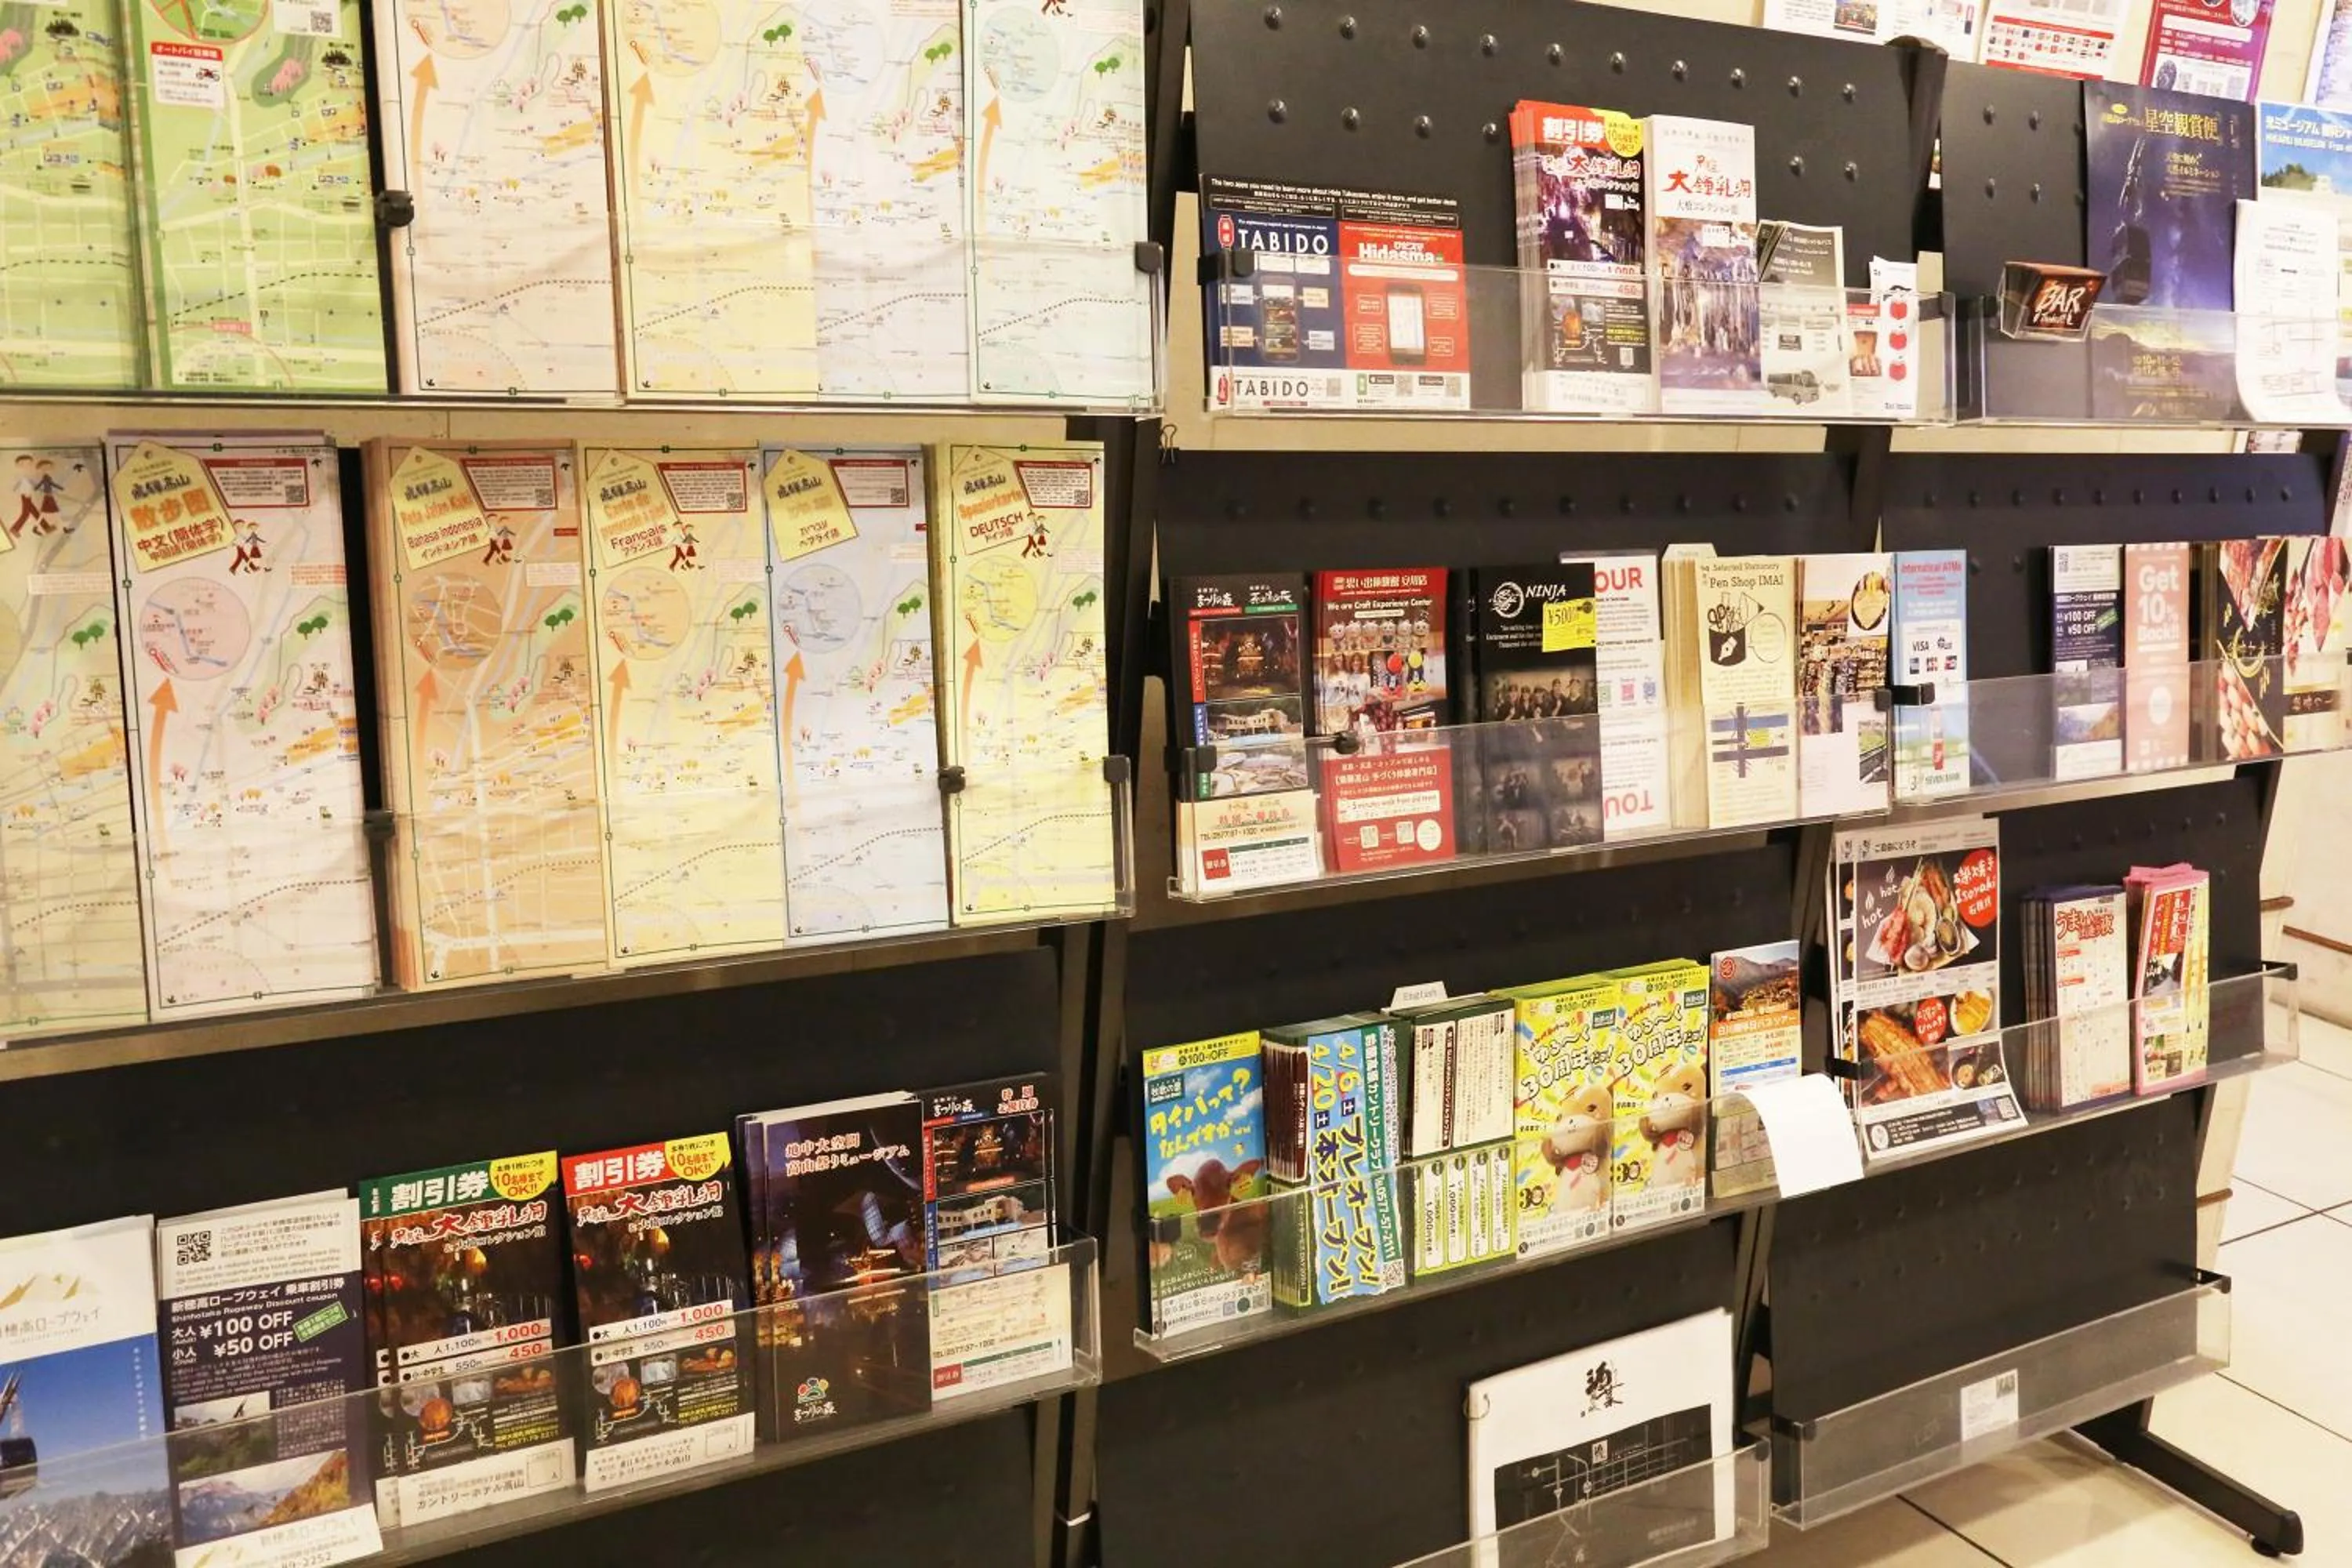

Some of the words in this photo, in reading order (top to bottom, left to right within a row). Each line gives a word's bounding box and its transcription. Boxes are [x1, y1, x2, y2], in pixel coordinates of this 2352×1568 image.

[1543, 117, 1606, 143] 割引券
[1238, 227, 1330, 256] TABIDO
[1358, 242, 1436, 263] Hidasma
[2035, 283, 2087, 314] BAR
[1234, 379, 1309, 397] TABIDO
[969, 510, 1024, 538] DEUTSCH
[1525, 583, 1567, 598] NINJA
[1594, 567, 1643, 593] OUR
[1710, 575, 1729, 589] Pen
[1730, 575, 1757, 590] Shop
[2137, 562, 2180, 593] Get
[1354, 600, 1372, 610] Craft
[1373, 598, 1410, 609] Experience
[1410, 597, 1433, 608] Center
[2083, 610, 2097, 622] OFF
[2083, 623, 2097, 634] OFF
[1912, 639, 1930, 652] VISA
[1880, 884, 1900, 898] hot
[1861, 907, 1884, 930] hot
[1312, 1043, 1338, 1110] 4/20
[575, 1149, 666, 1190] 割引券
[390, 1170, 489, 1212] 割引券
[506, 1184, 538, 1198] OK!!
[1341, 1114, 1380, 1284] プレオープン!
[1314, 1131, 1351, 1293] 本オープン!
[171, 1287, 281, 1313] 新穂高ロープウェイ
[285, 1277, 345, 1296] 乗車割引券
[0, 1307, 102, 1335] 穂高ロープウェイ
[171, 1308, 222, 1323] Shinhotaka
[266, 1296, 305, 1308] Discount
[171, 1325, 197, 1339] 大人
[199, 1317, 253, 1339] ¥100
[258, 1310, 294, 1329] OFF
[172, 1346, 197, 1359] 小人
[213, 1338, 253, 1359] ¥50
[258, 1331, 294, 1350] OFF
